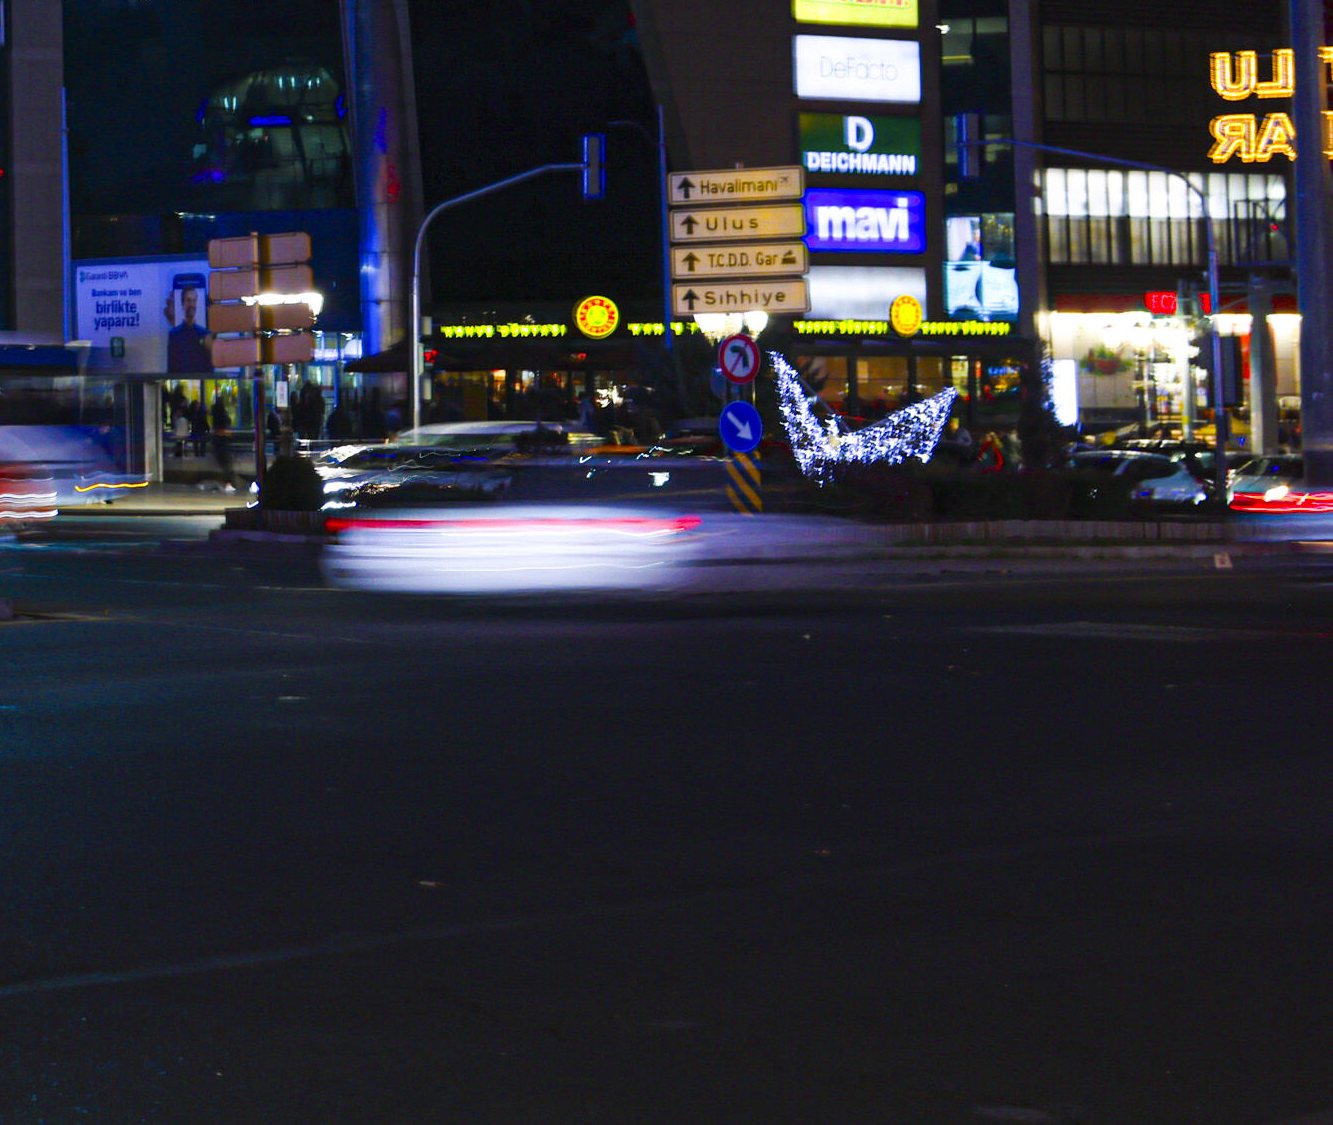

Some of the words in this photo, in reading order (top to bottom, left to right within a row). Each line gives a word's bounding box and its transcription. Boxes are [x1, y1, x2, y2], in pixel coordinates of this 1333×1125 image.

[820, 55, 898, 82] DeFacto
[844, 115, 876, 153] D
[804, 151, 918, 175] DEICHMANN
[700, 178, 779, 195] Havalimanı
[705, 216, 759, 232] Ulus
[817, 197, 910, 242] mavi
[708, 252, 752, 268] T.C.D.D.
[755, 251, 779, 266] Gar
[128, 288, 142, 296] ben
[704, 289, 786, 307] Sıhhiye
[95, 300, 137, 315] birlikte
